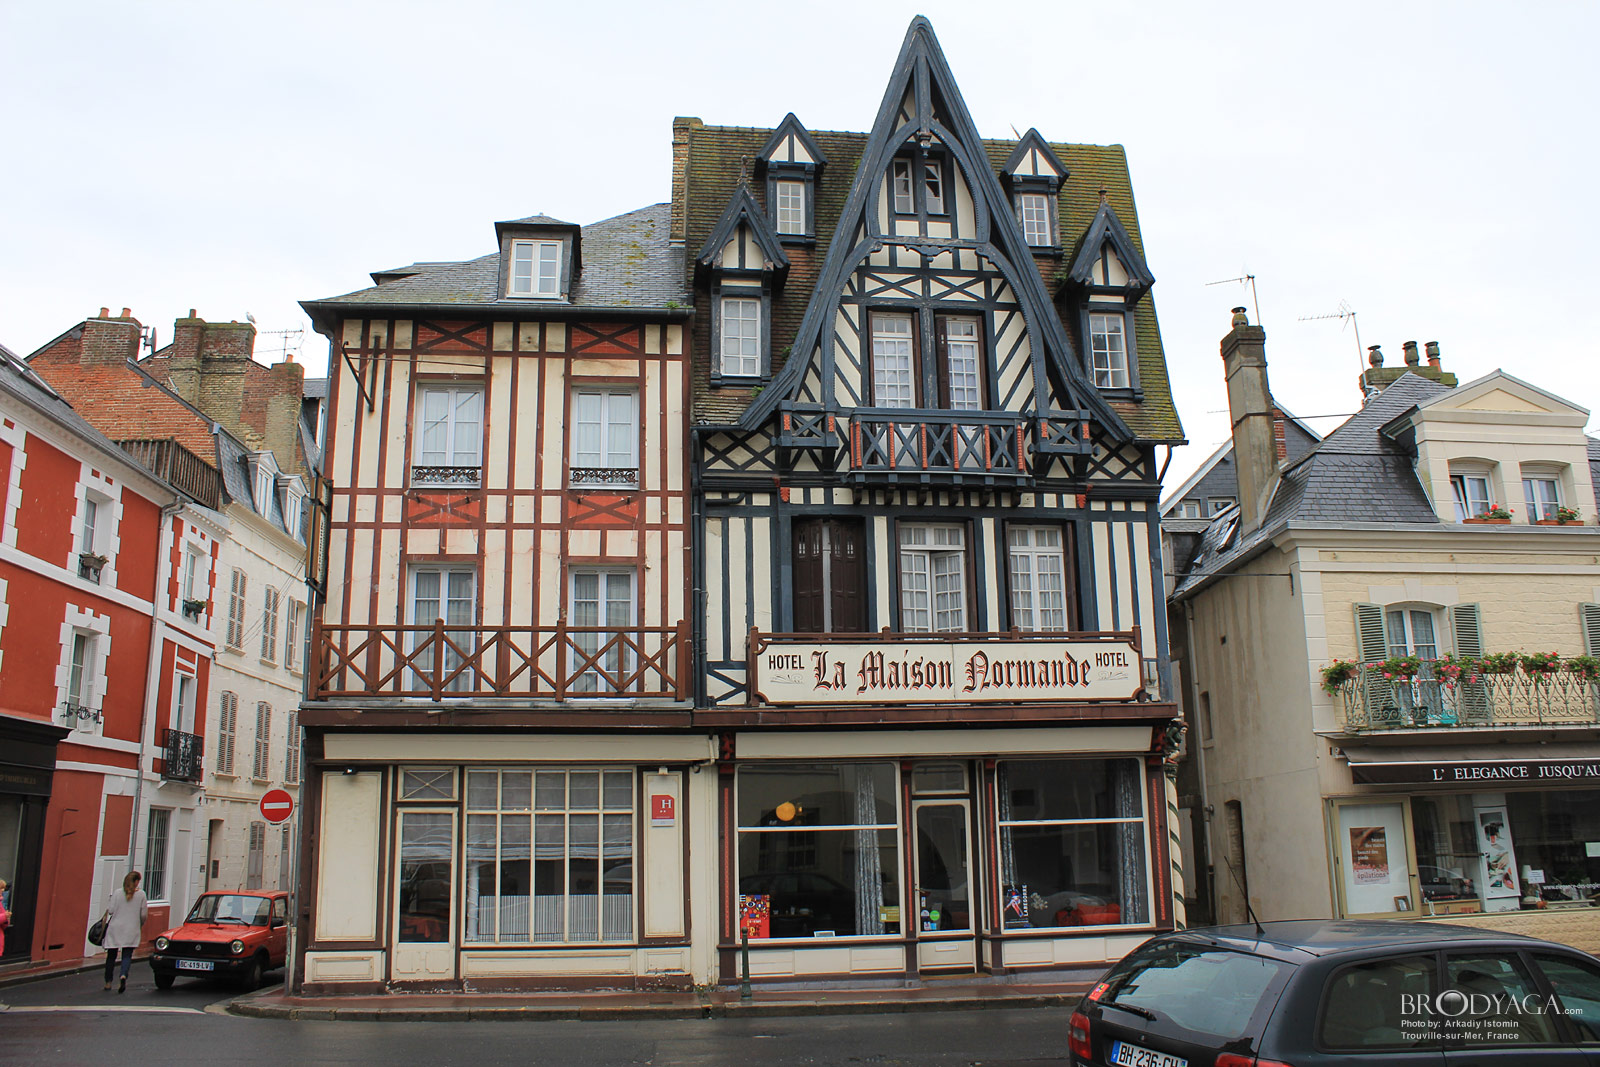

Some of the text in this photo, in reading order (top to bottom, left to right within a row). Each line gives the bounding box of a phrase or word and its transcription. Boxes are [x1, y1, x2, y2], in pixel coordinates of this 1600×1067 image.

[768, 654, 805, 670] HOTEL
[1095, 652, 1129, 667] HOTEL
[811, 649, 1091, 695] La Maison Normande
[1432, 768, 1445, 781] L'
[1454, 766, 1529, 780] ELEGANCE
[661, 799, 672, 809] H
